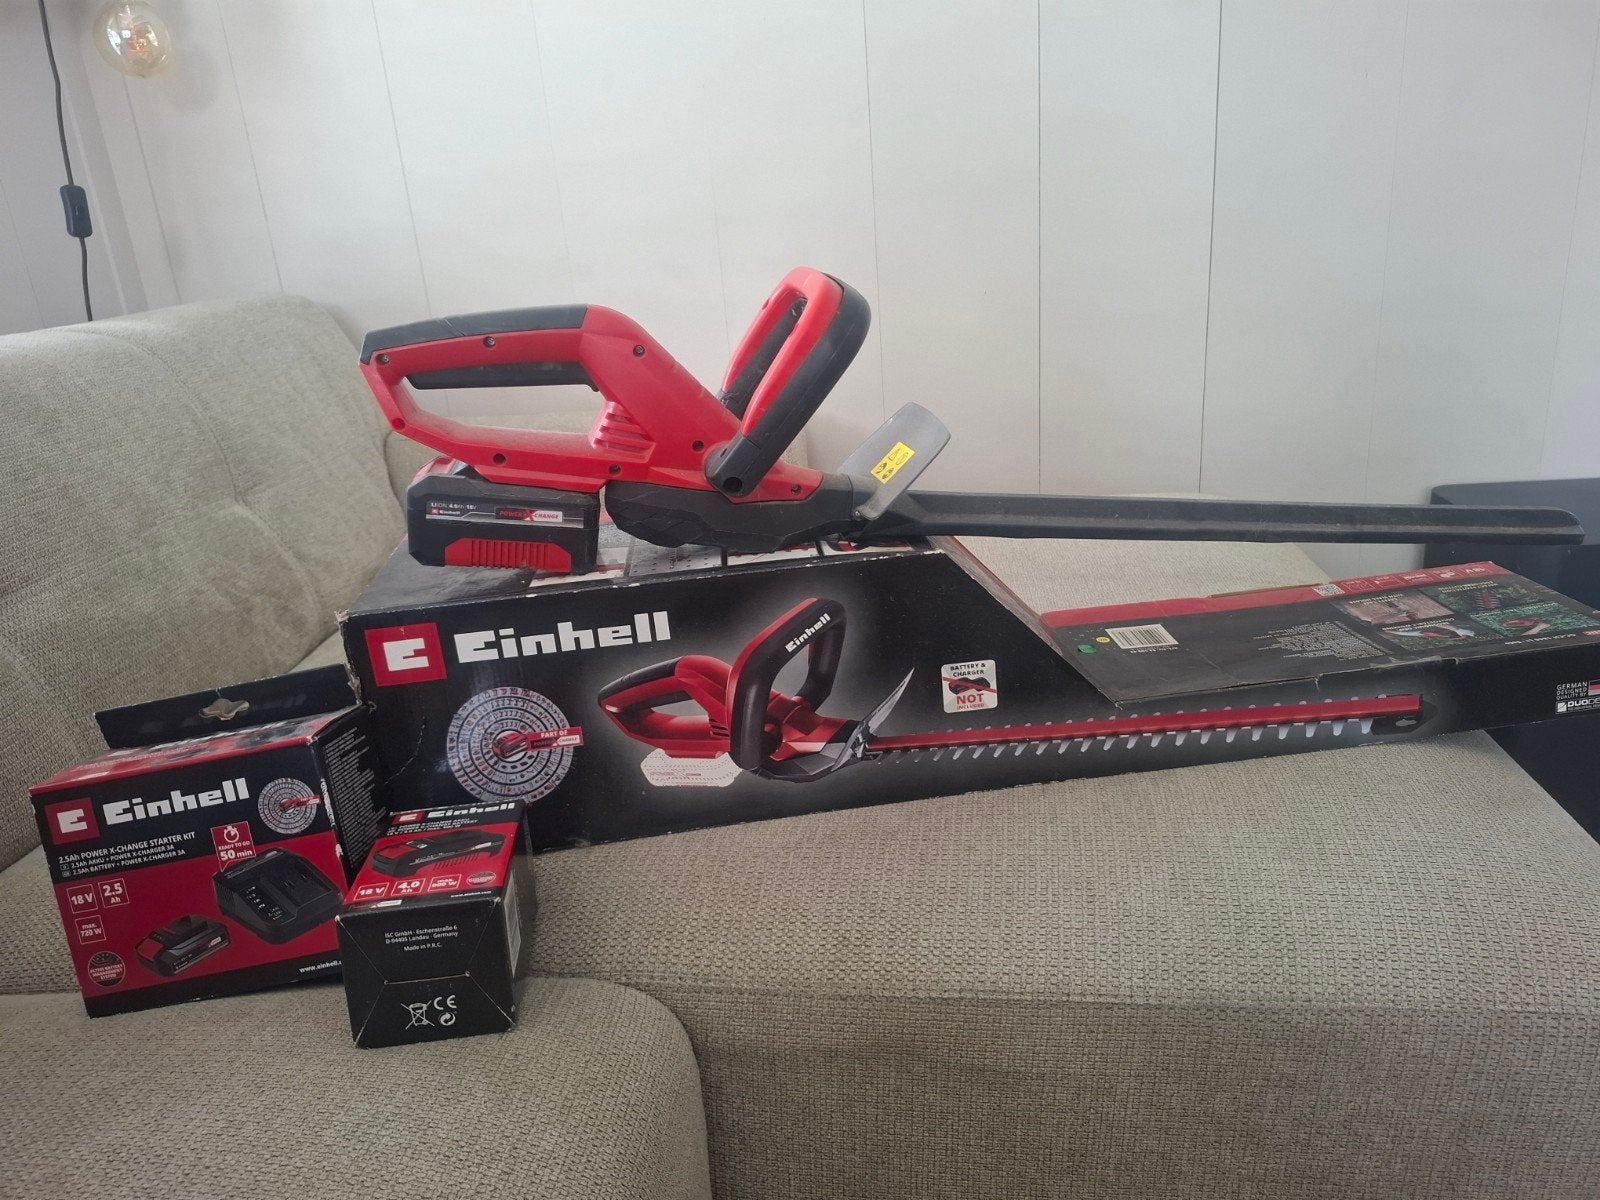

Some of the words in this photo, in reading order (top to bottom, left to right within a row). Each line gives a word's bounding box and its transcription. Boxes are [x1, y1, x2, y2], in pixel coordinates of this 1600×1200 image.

[454, 611, 671, 663] Einhell
[785, 613, 830, 653] Einhell
[950, 663, 979, 671] BATTERY
[1557, 682, 1588, 691] GERMAN
[1557, 687, 1587, 696] DESIGNED
[957, 694, 984, 705] NOT
[102, 778, 250, 826] Einhell
[427, 802, 515, 818] Einhell
[58, 854, 80, 864] 2.5Ah
[81, 848, 108, 859] POWER
[109, 841, 148, 855] X-CHANGE
[149, 835, 182, 846] STARTER
[183, 831, 195, 840] KIT
[218, 842, 234, 850] READY
[88, 858, 105, 866] AKKU
[110, 853, 131, 861] POWER
[132, 847, 165, 857] X-CHARGER
[220, 850, 236, 860] 50
[237, 850, 252, 858] min
[90, 863, 115, 872] BATTERY
[121, 858, 143, 866] POWER
[143, 851, 177, 862] X-CHARGER
[103, 883, 123, 897] 2.5
[398, 881, 420, 889] 4.0
[359, 888, 374, 896] 18
[71, 895, 84, 905] 18
[84, 893, 93, 903] V
[110, 896, 121, 904] Ah
[80, 929, 94, 937] 720
[416, 925, 453, 935] Eschenstraße
[433, 931, 459, 939] Germany
